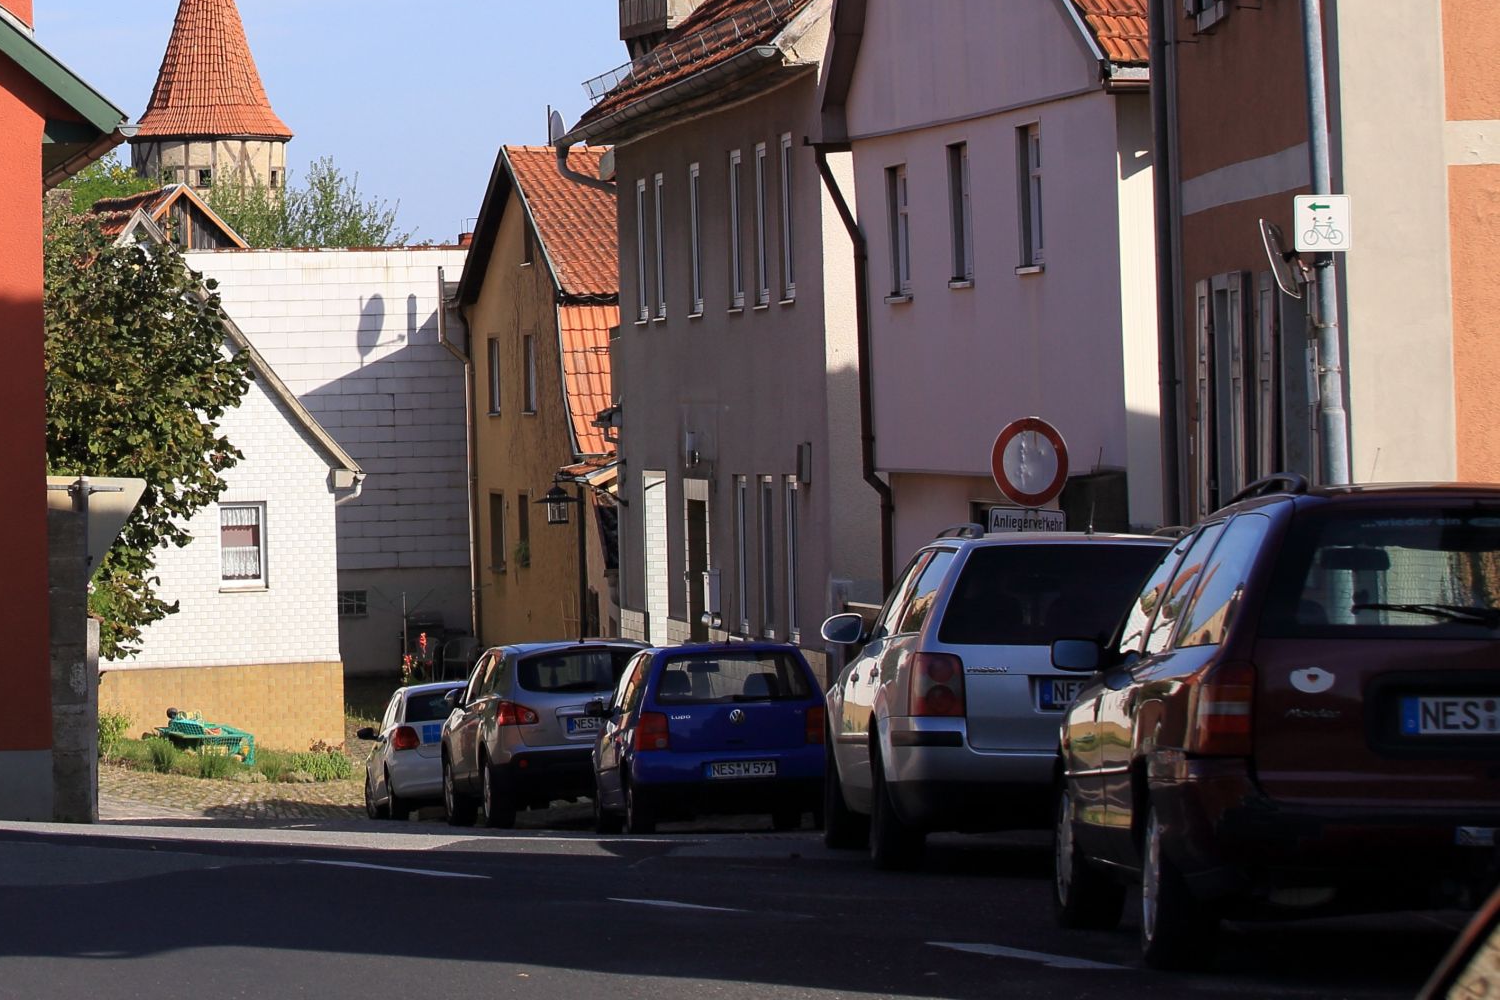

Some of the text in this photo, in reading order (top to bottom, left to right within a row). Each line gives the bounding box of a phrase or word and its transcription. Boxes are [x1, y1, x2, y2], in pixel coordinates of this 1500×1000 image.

[994, 514, 1063, 532] Anliegerverkehr
[1054, 682, 1084, 702] NE
[574, 718, 594, 729] NES
[1421, 701, 1480, 730] NES
[712, 764, 735, 776] NES
[753, 761, 774, 775] 571
